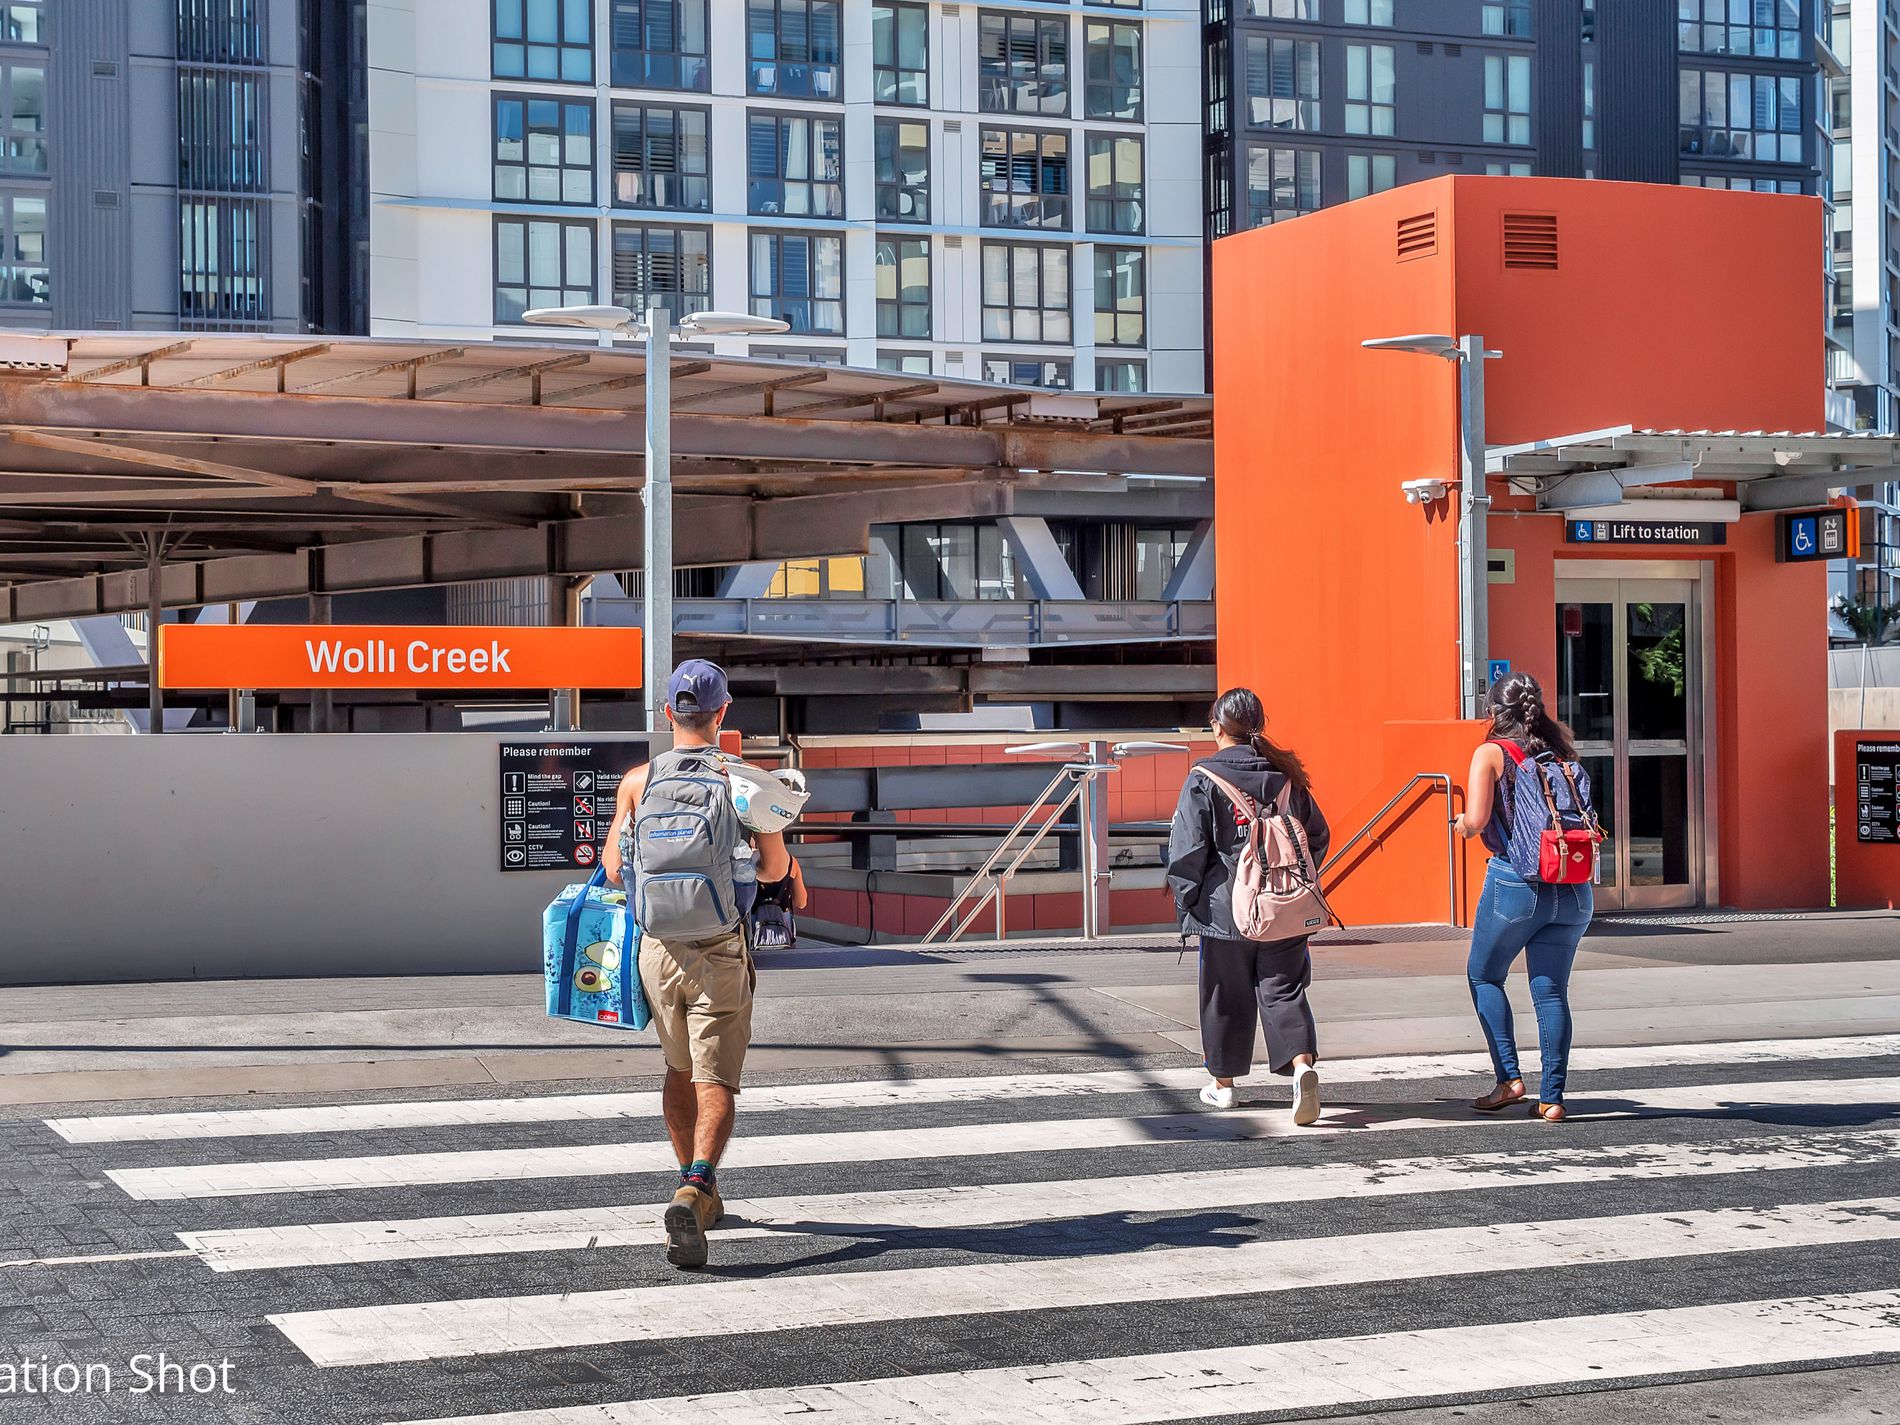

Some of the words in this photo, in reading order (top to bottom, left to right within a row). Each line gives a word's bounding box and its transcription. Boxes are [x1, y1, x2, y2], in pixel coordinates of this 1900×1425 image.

[1613, 524, 1635, 538] Lift
[1638, 525, 1652, 539] to
[1654, 525, 1699, 540] station
[305, 639, 395, 673] Wolli
[407, 640, 512, 673] Creek
[503, 747, 537, 757] Please
[539, 746, 592, 756] remember
[1857, 744, 1876, 752] Please
[599, 1014, 618, 1022] coles
